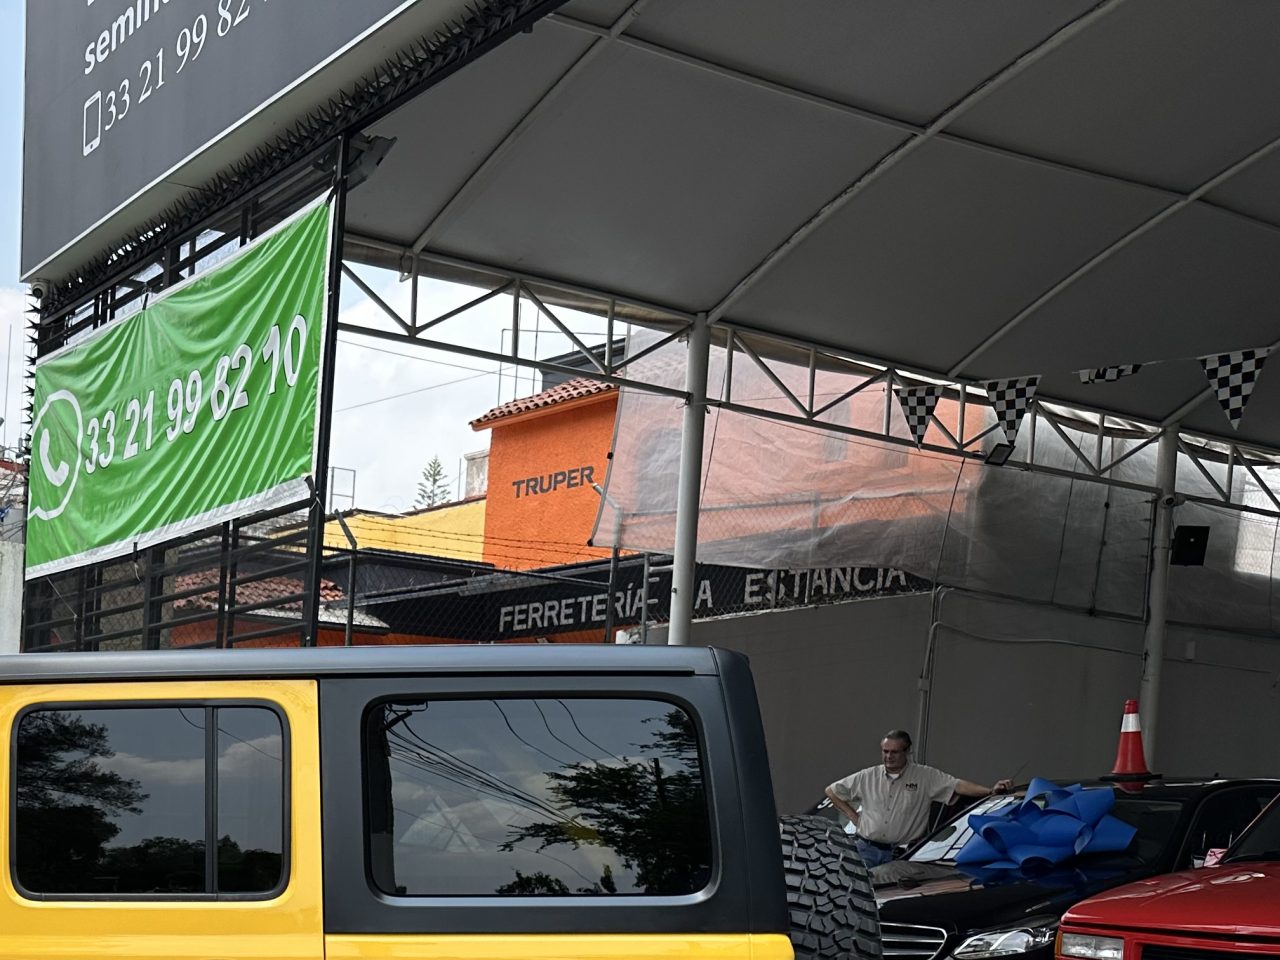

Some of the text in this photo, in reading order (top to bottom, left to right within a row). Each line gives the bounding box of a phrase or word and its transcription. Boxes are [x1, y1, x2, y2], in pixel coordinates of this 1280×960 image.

[85, 0, 169, 75] semin
[105, 0, 250, 130] 33 21 99 82
[85, 314, 307, 474] 33 21 99 82 10
[511, 465, 595, 498] TRUPER
[498, 583, 647, 633] FERRETERÍA
[744, 566, 908, 604] ESTANCIA
